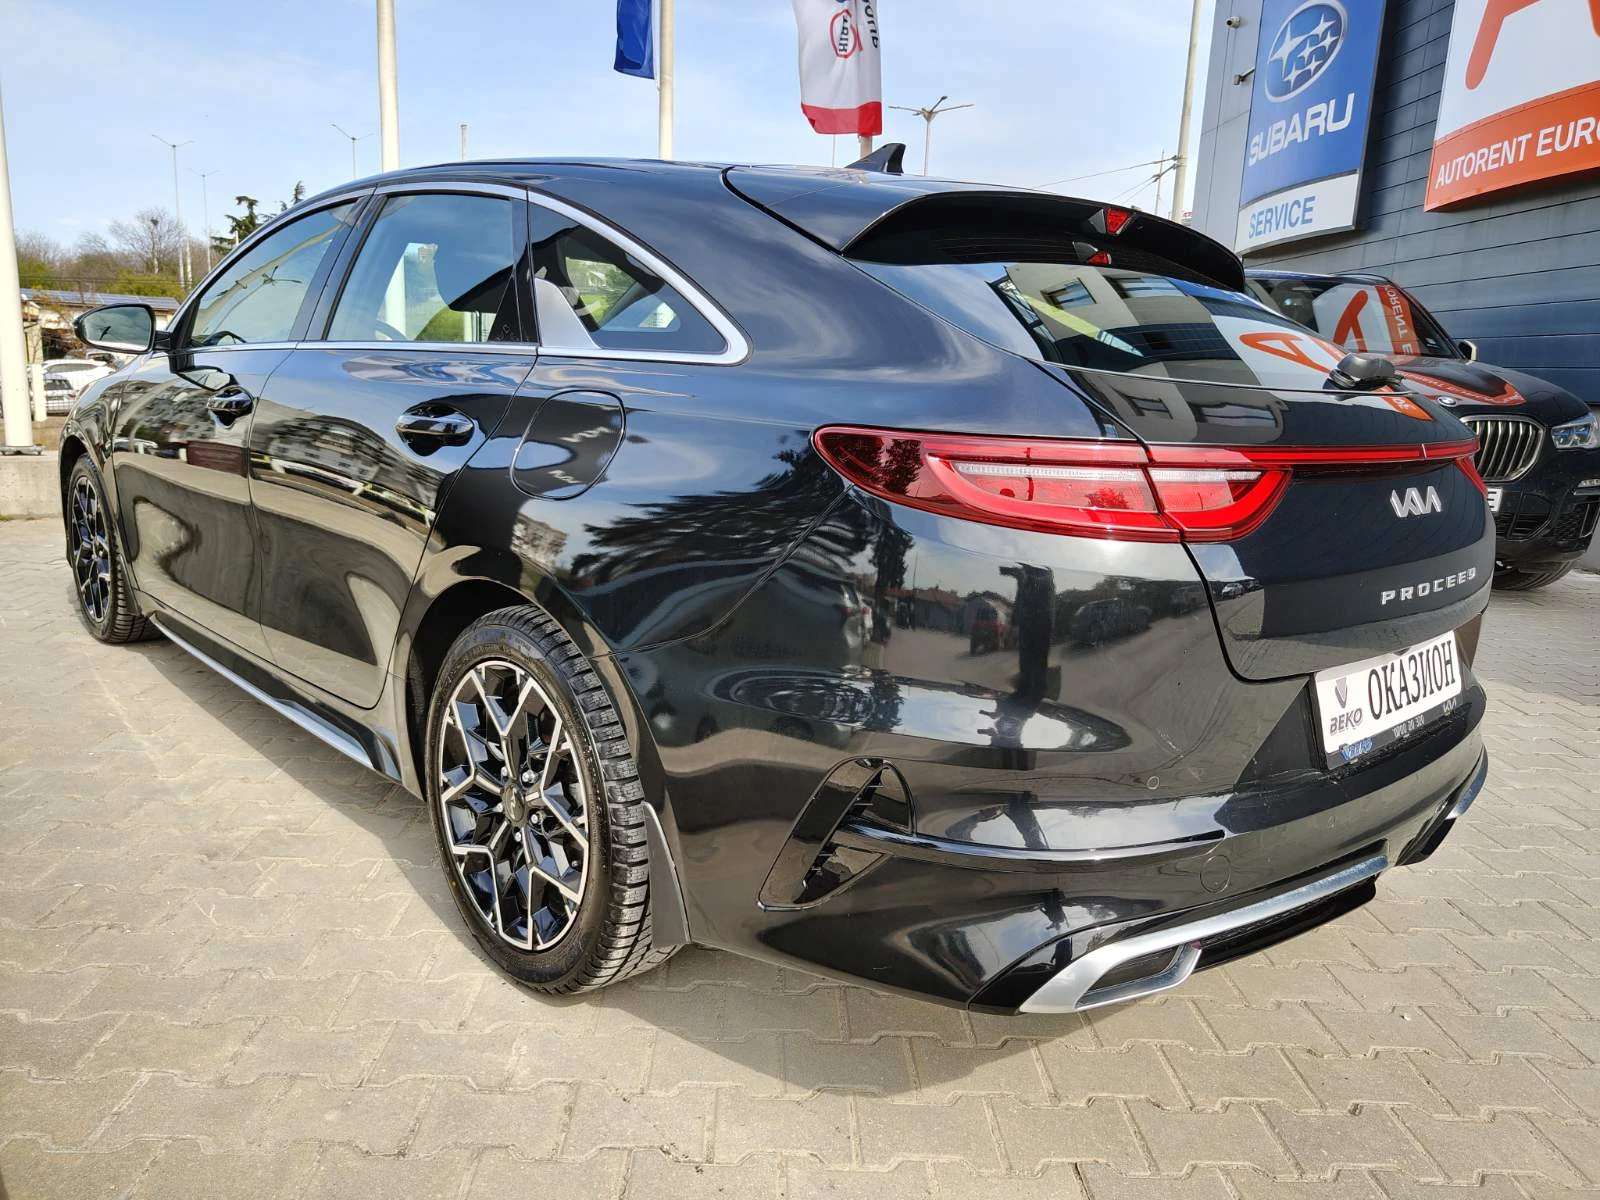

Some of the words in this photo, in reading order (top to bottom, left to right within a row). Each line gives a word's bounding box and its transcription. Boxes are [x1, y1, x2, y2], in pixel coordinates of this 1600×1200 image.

[1248, 93, 1355, 167] SUBARU
[1435, 132, 1533, 189] AUTORENT
[1536, 116, 1600, 157] EUR
[1248, 196, 1316, 239] SERVICE
[1381, 566, 1477, 605] PROCEED
[1367, 640, 1456, 721] ОКАЗИОН
